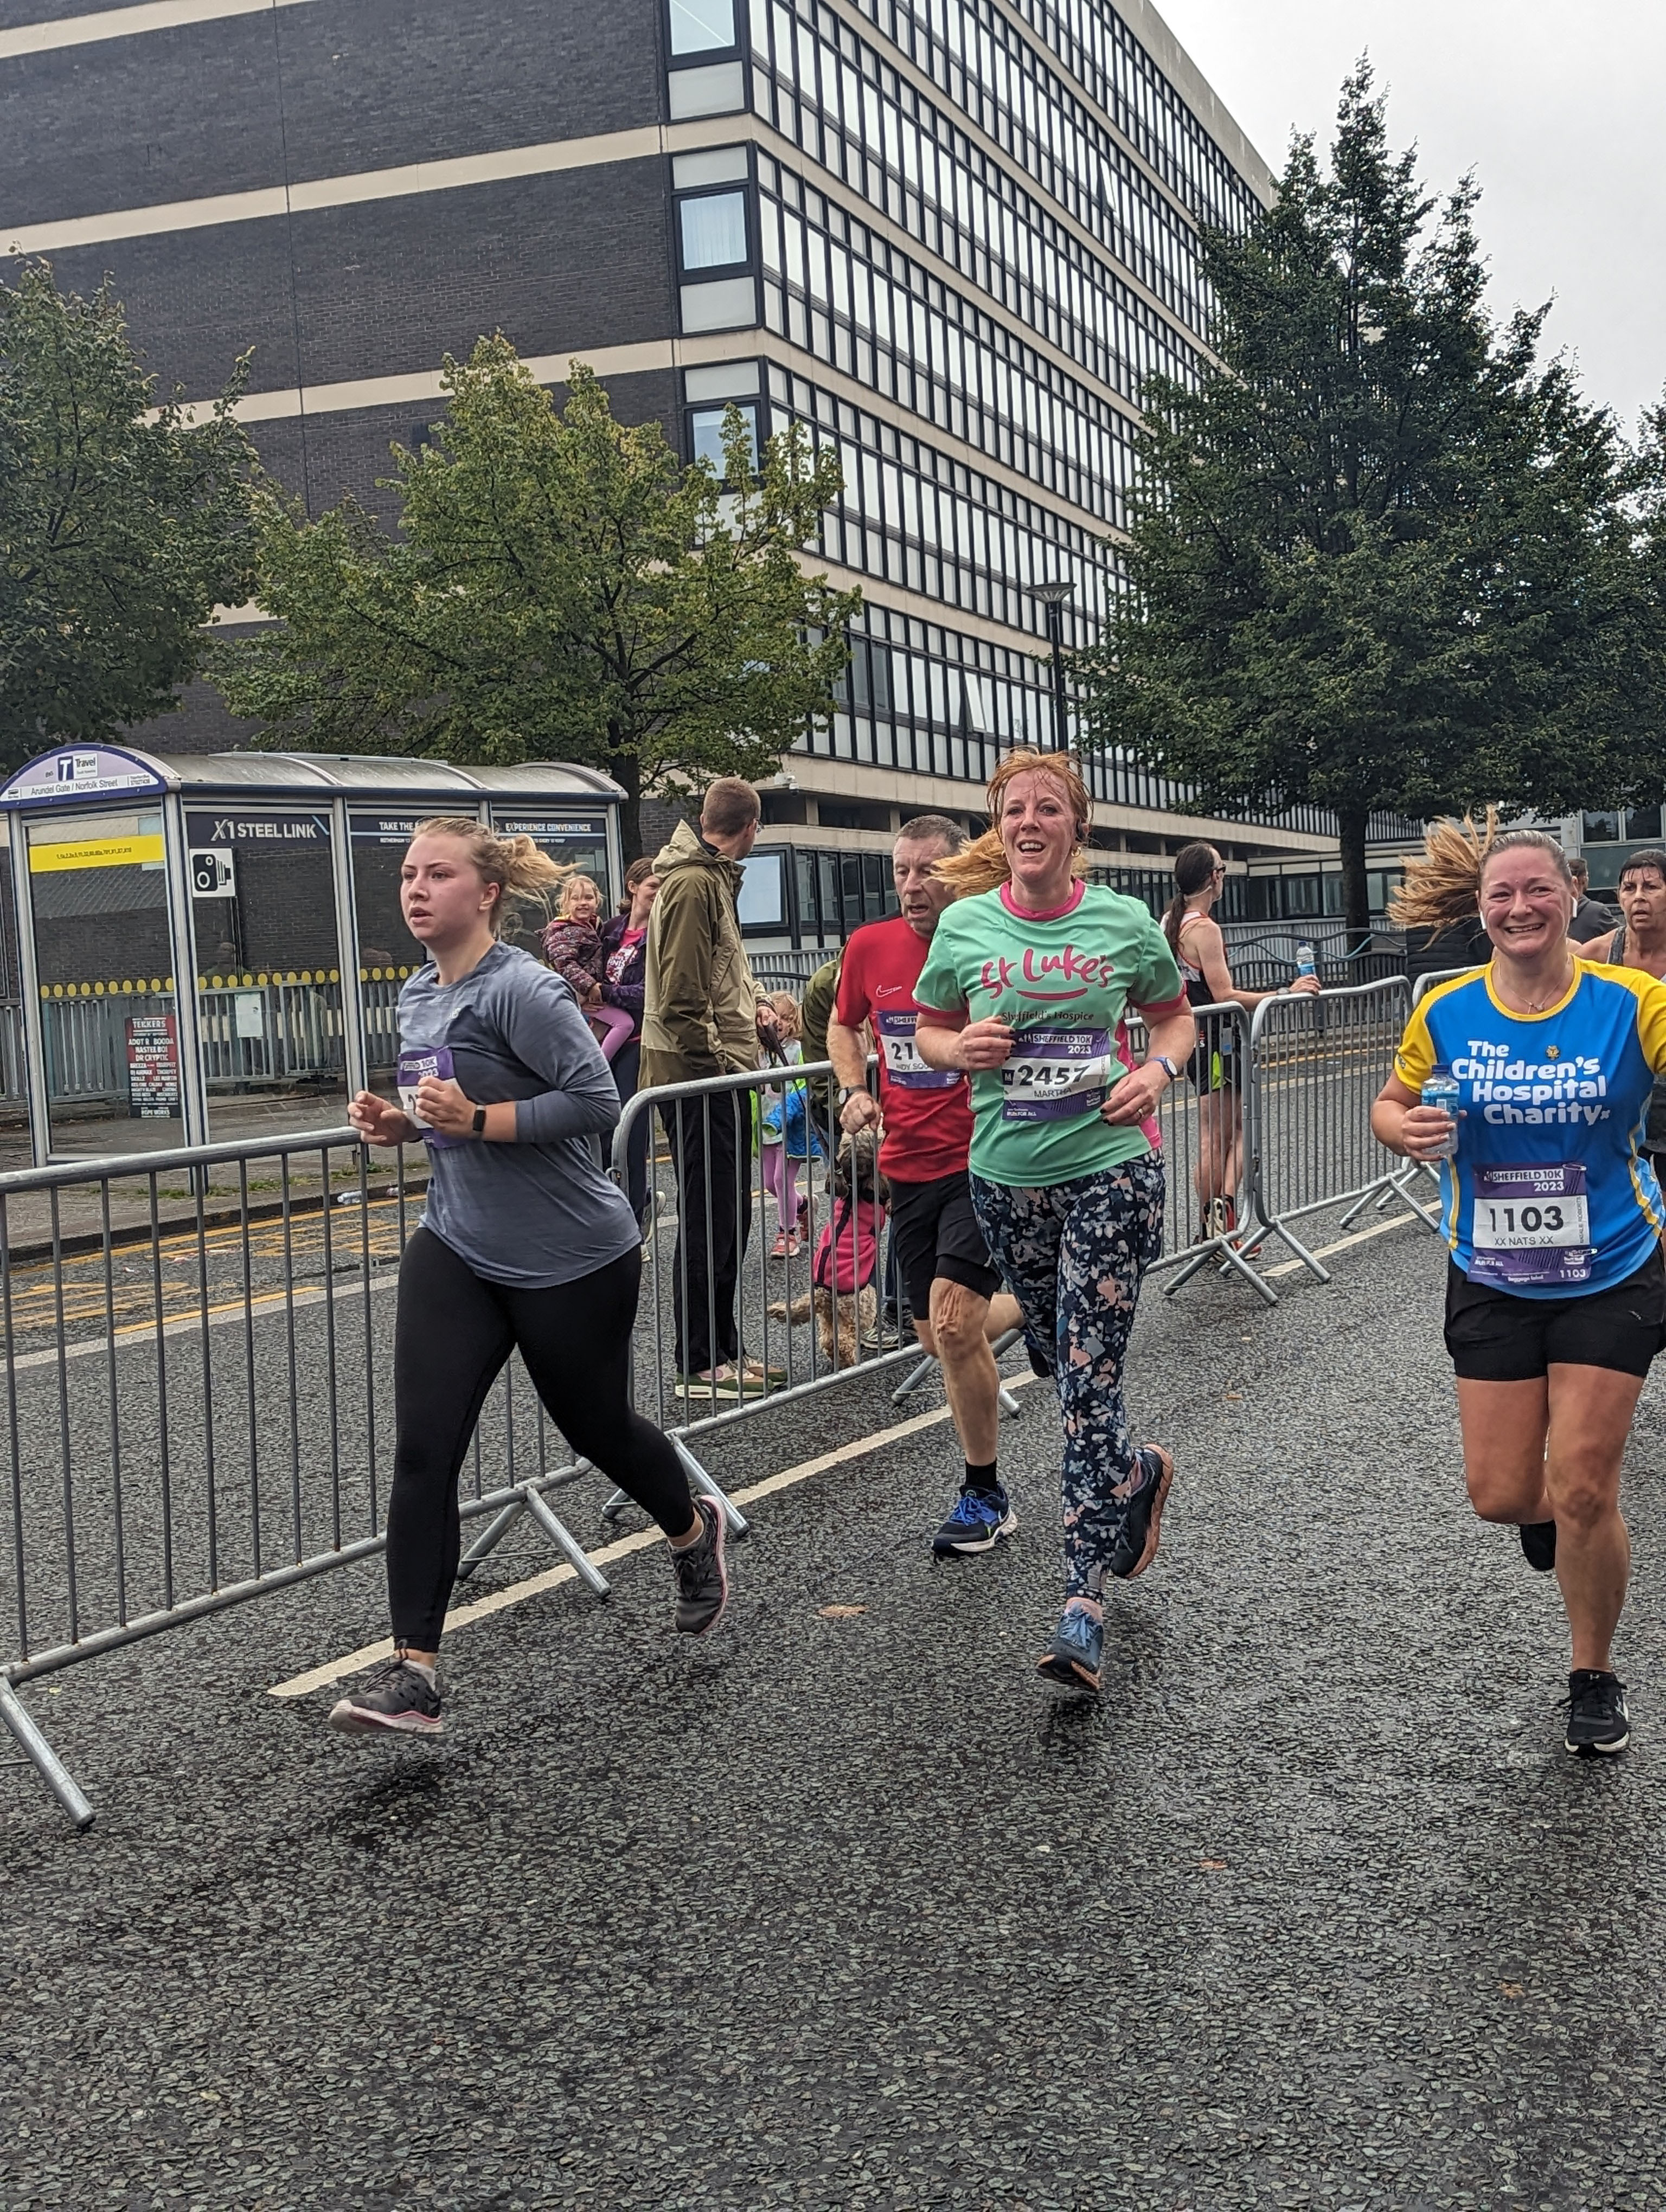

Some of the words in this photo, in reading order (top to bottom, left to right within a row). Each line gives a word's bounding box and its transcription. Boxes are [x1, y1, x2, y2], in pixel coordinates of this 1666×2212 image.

[75, 757, 95, 768] Travel
[31, 786, 54, 795] Arundel
[56, 783, 71, 792] Gate
[75, 781, 98, 790] Norfolk
[99, 779, 118, 788] Street
[210, 819, 235, 841] X1
[379, 822, 398, 831] TAKE
[399, 822, 413, 831] THE
[505, 822, 546, 832] EXPERIENCE
[547, 824, 591, 832] CONVENIENCE
[981, 956, 1017, 999] St
[1023, 944, 1114, 988] Luke's
[1003, 1011, 1051, 1022] Sheffield's
[1054, 1011, 1094, 1021] Hospice
[1034, 1035, 1075, 1044] SHEFFIELD
[1077, 1035, 1092, 1044] 10K
[891, 1042, 913, 1060] 21
[1067, 1045, 1092, 1054] 2023
[1468, 1040, 1509, 1057] The
[1452, 1056, 1600, 1081] Children's
[1017, 1065, 1091, 1086] 2457
[1034, 1087, 1072, 1098] MARTHA
[1472, 1076, 1606, 1105] Hospital
[1484, 1103, 1601, 1126] Charity
[1494, 1171, 1541, 1181] SHEFFIELD
[1543, 1169, 1562, 1179] 10K
[1534, 1181, 1565, 1192] 2023
[1489, 1206, 1564, 1232] 1103
[1495, 1238, 1506, 1246] XX
[1508, 1237, 1536, 1246] NATS
[1539, 1236, 1554, 1244] XX
[1560, 1269, 1586, 1278] 1103
